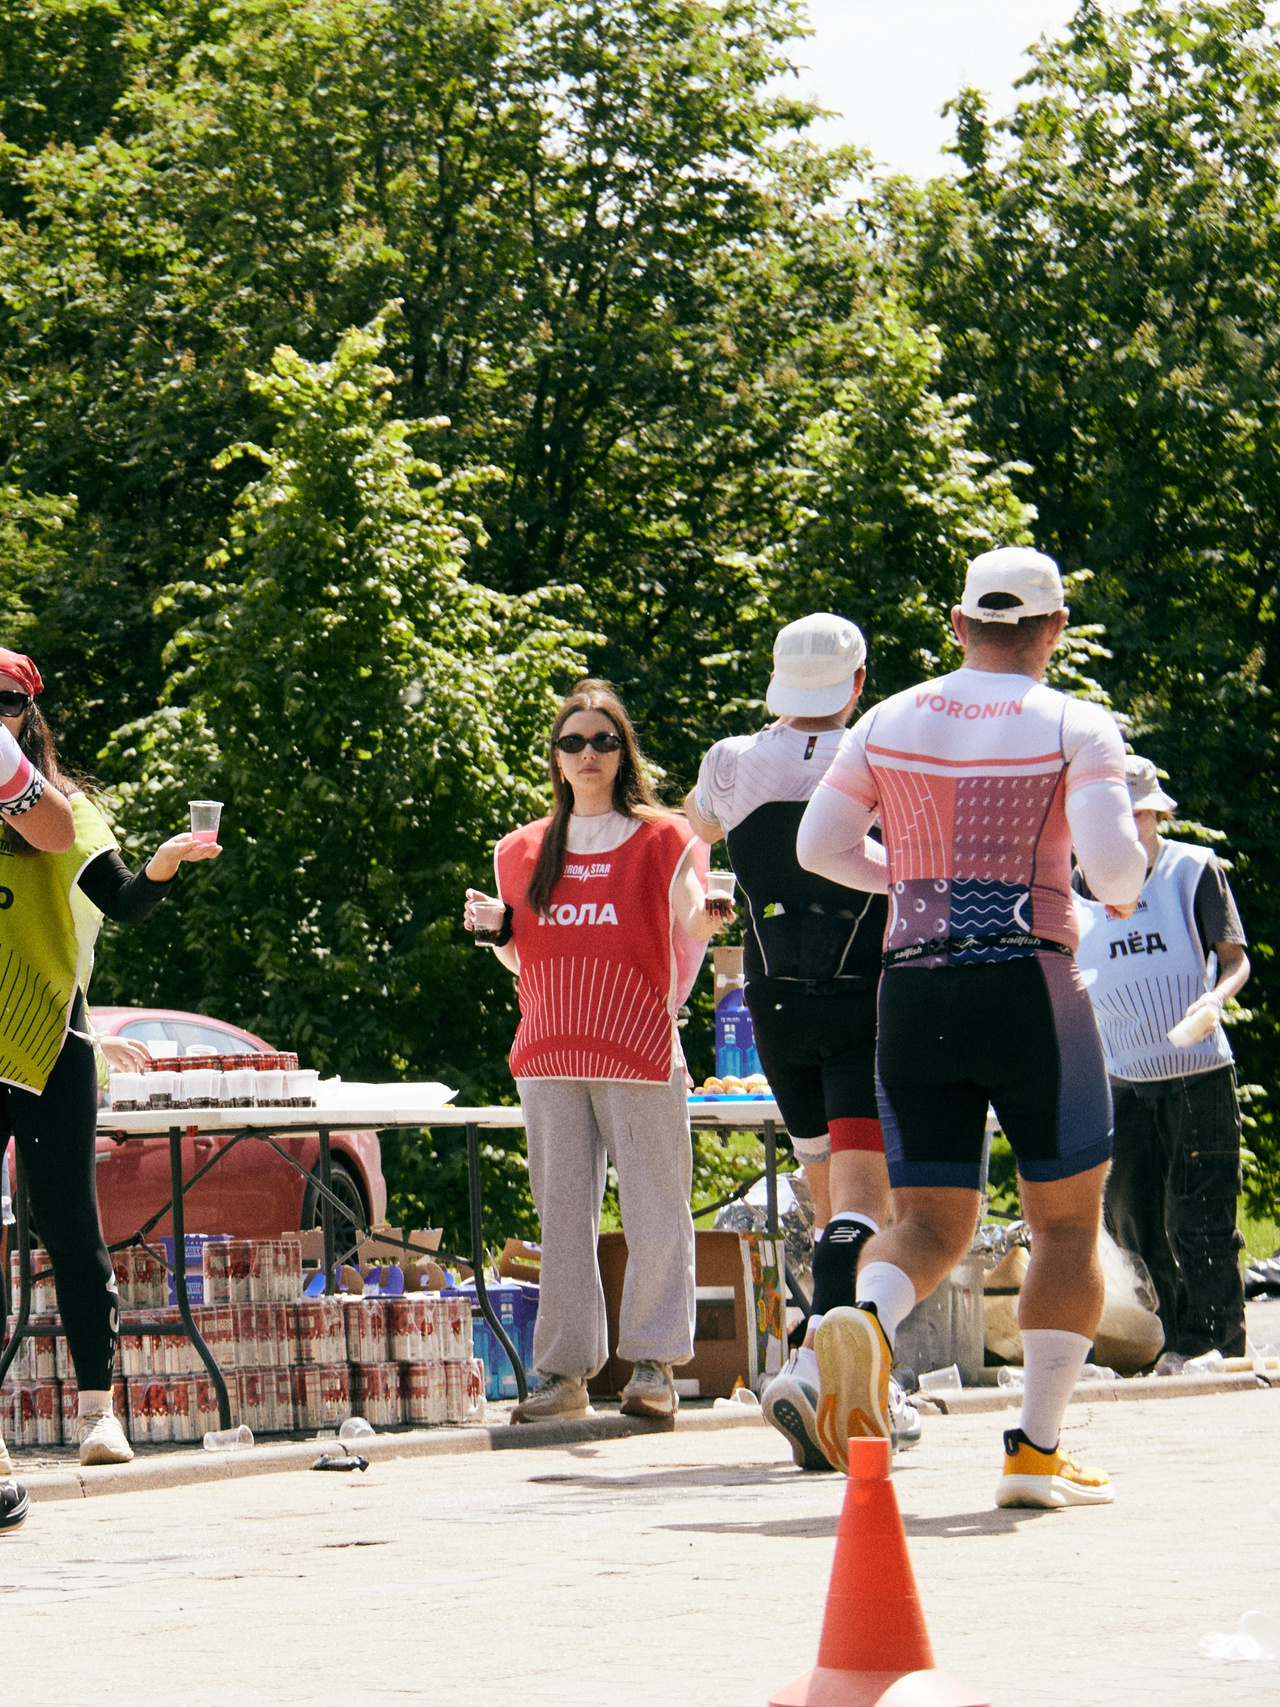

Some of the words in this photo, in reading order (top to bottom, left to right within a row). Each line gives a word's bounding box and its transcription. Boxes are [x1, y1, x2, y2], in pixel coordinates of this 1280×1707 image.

[915, 692, 1024, 720] VORONIN
[564, 864, 585, 875] IRON
[590, 863, 611, 874] STAR
[538, 903, 618, 926] КОЛА
[999, 936, 1042, 946] sailfish
[1109, 930, 1168, 959] ЛЁД
[893, 946, 923, 960] sailfish
